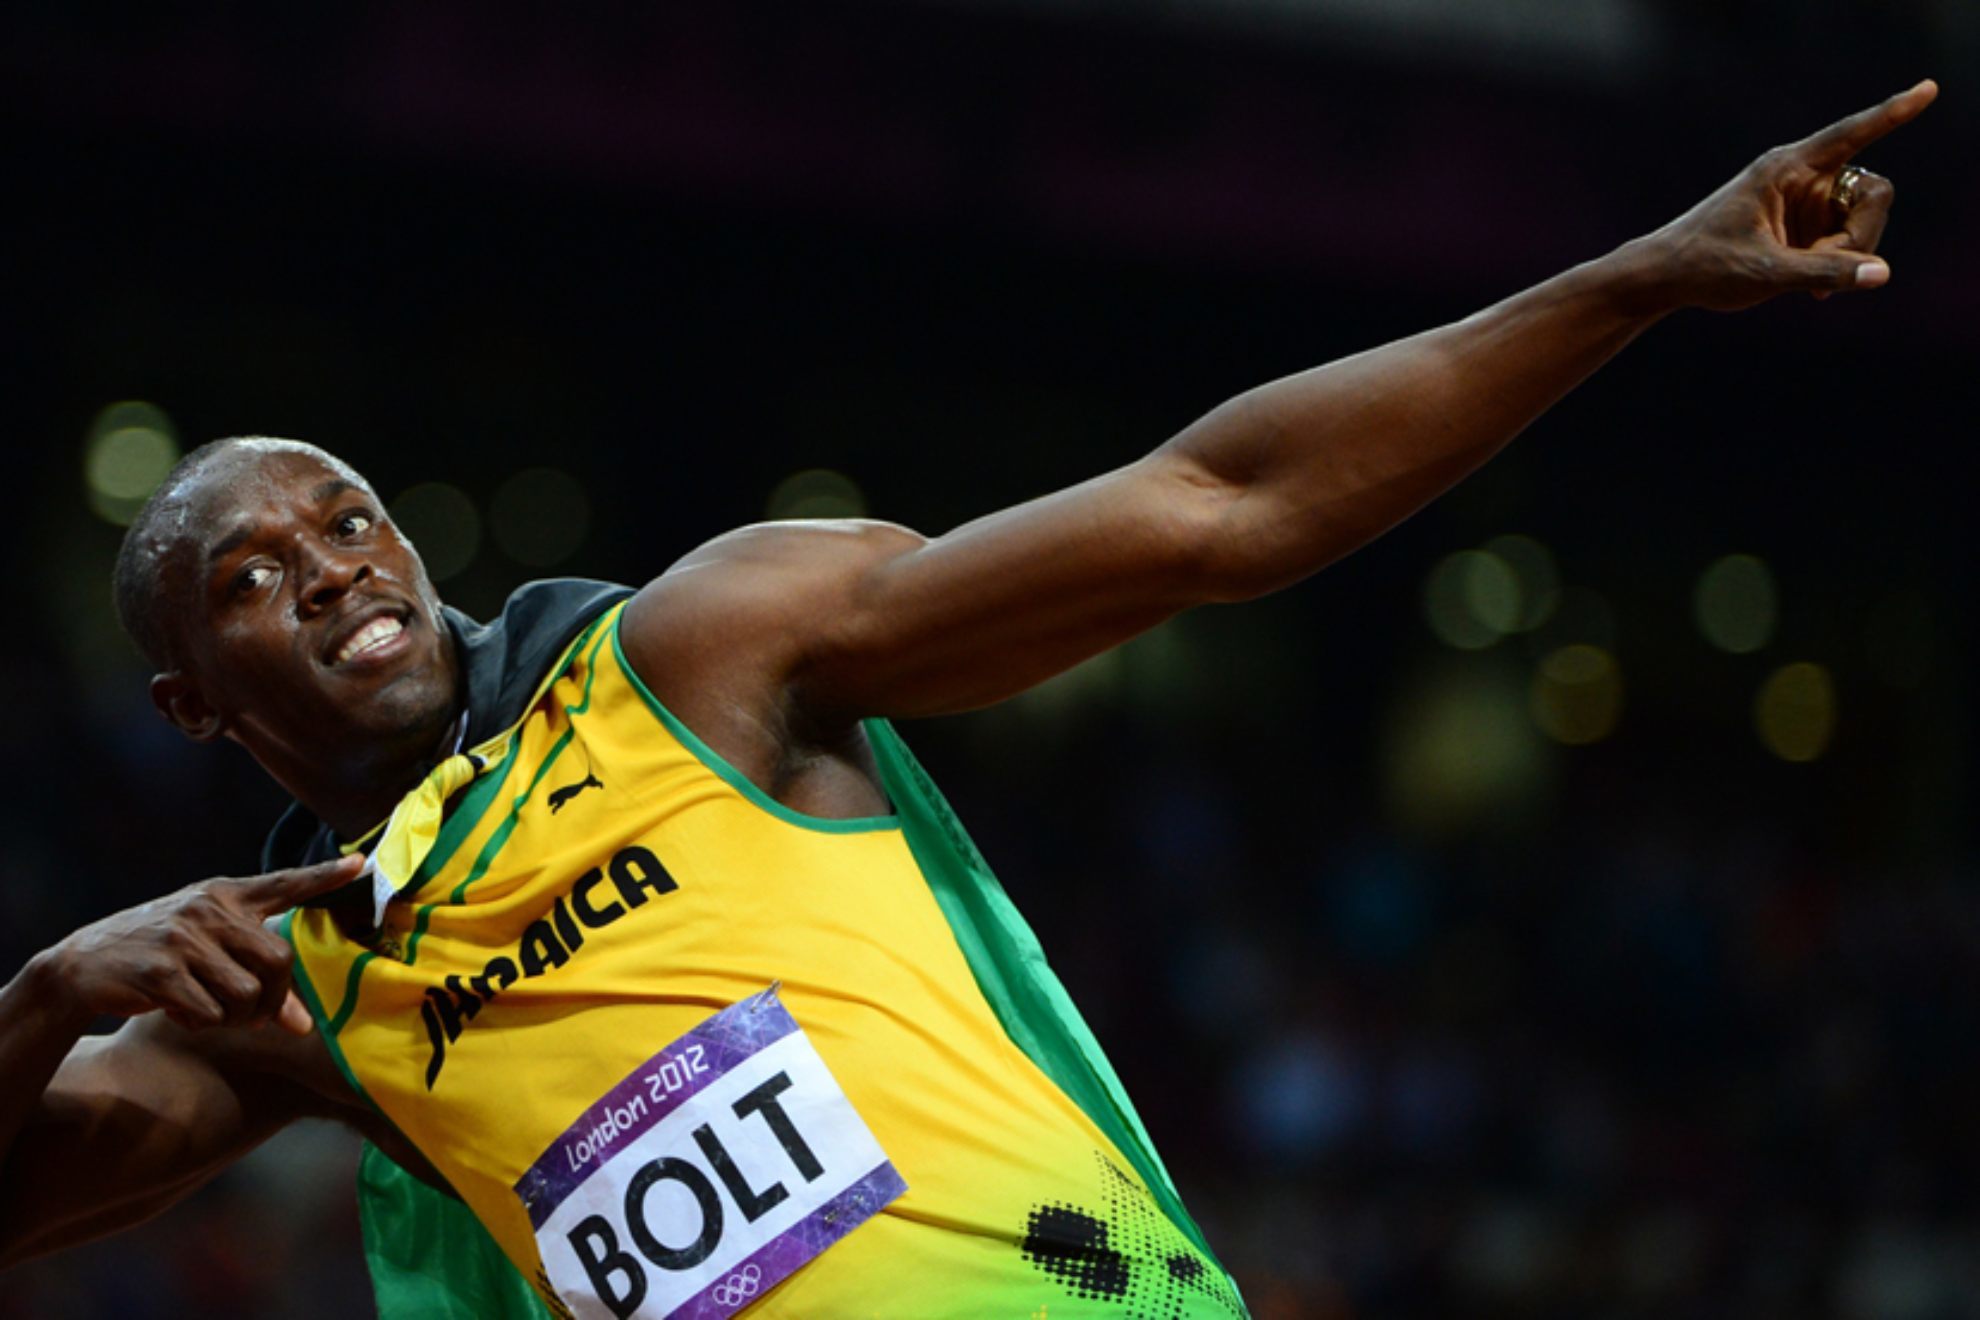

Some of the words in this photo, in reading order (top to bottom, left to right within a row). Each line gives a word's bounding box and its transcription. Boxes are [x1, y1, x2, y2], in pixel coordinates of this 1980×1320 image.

[565, 1094, 650, 1174] London
[644, 1043, 710, 1105] 2012
[566, 1069, 826, 1320] BOLT
